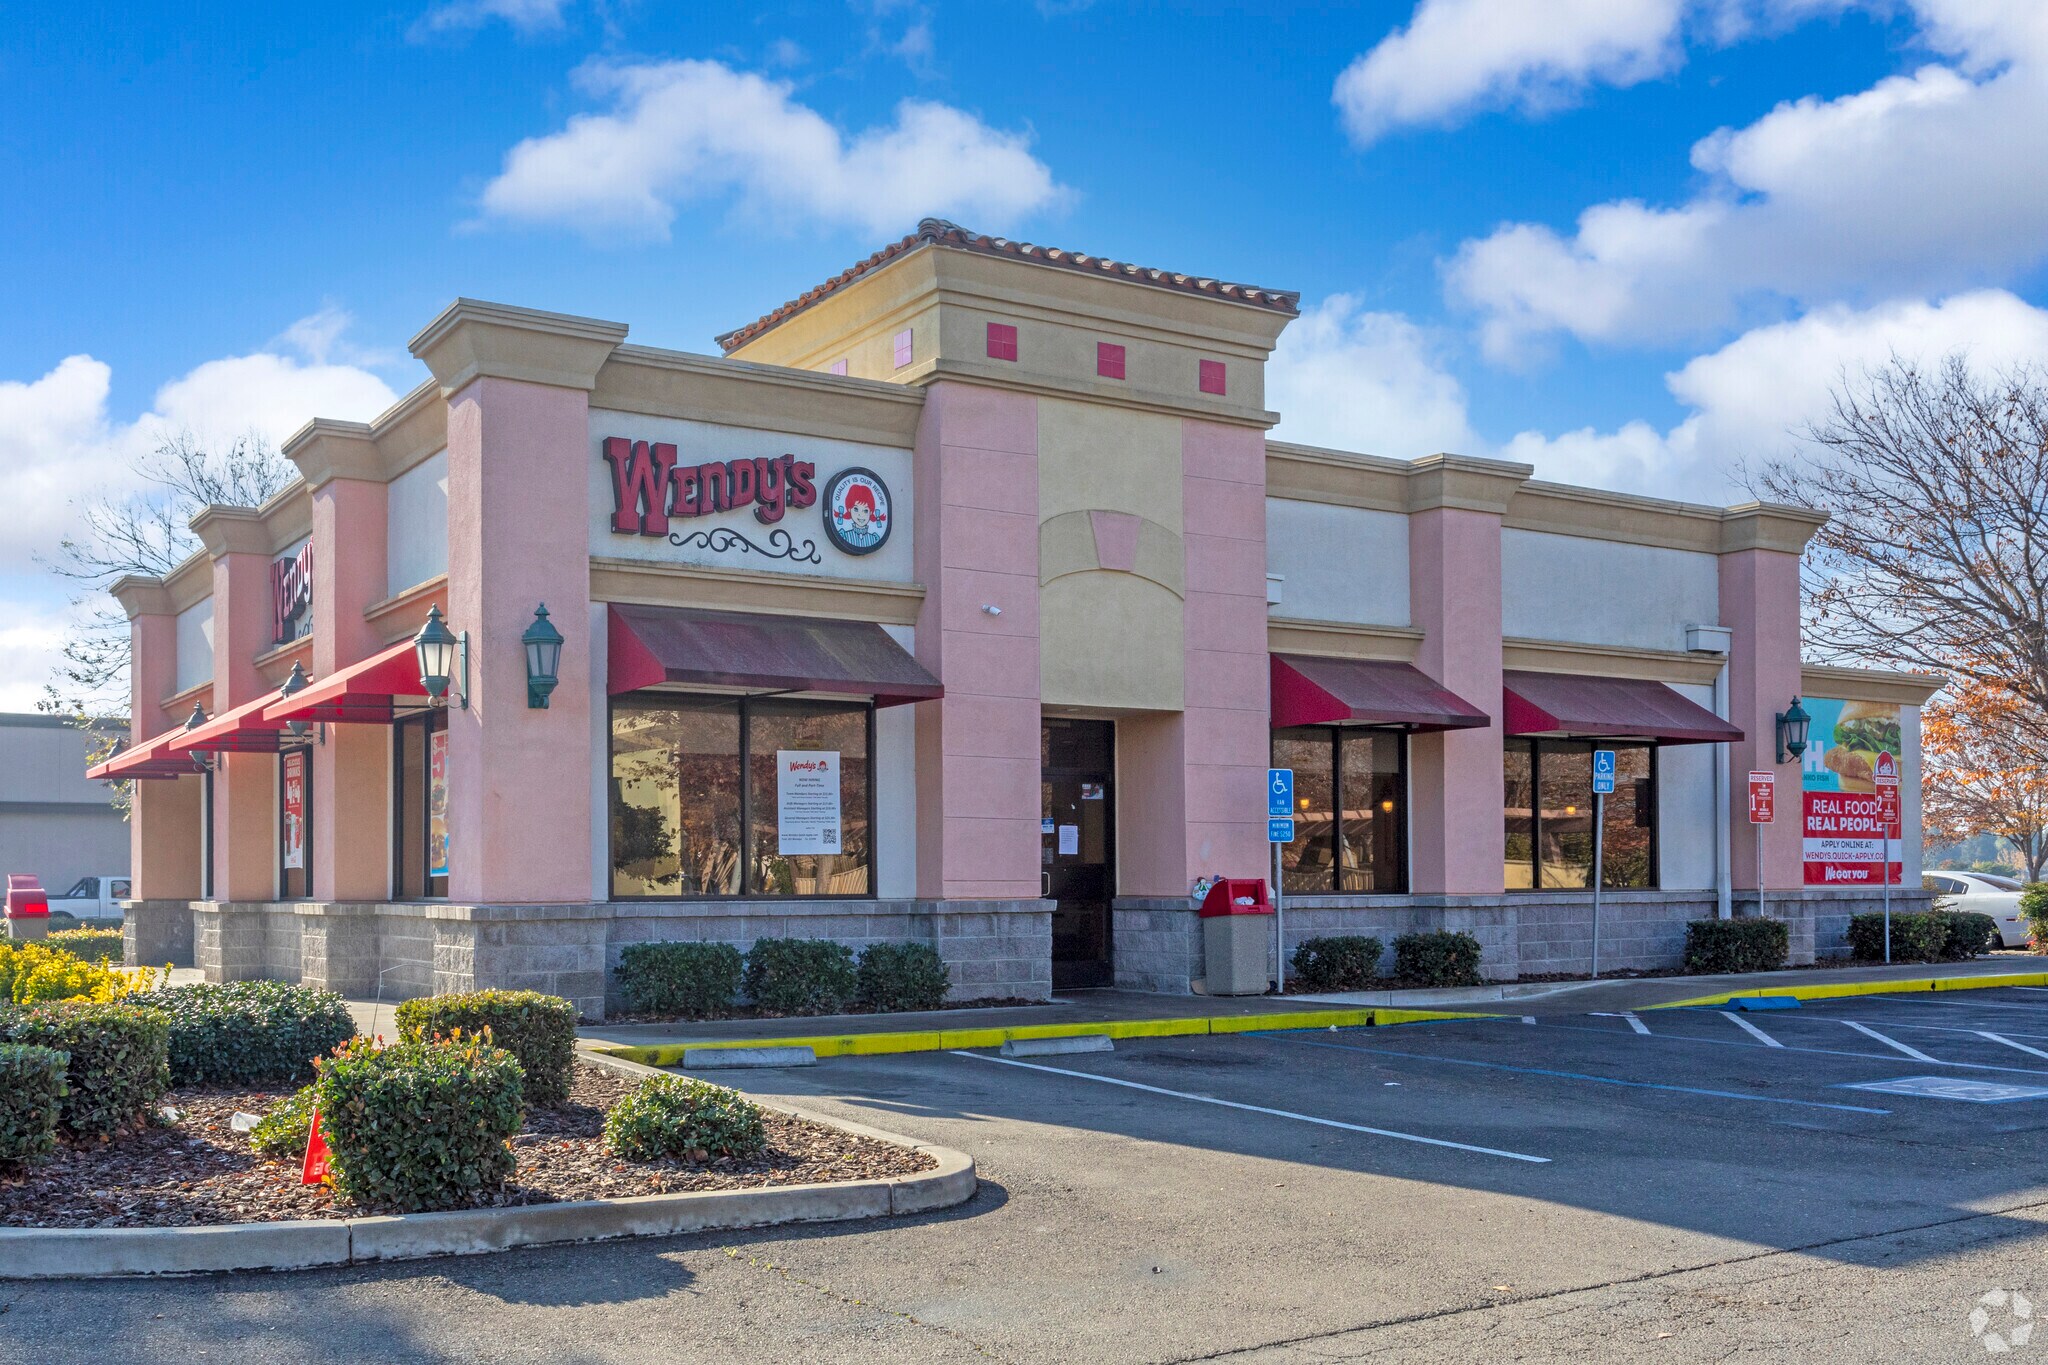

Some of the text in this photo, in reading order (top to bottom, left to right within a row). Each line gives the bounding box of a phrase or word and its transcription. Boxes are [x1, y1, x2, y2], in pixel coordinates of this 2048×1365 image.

[602, 436, 818, 537] Wendy's
[834, 479, 852, 501] QUALITY
[859, 477, 873, 487] OUR
[872, 484, 886, 506] RECIPE
[270, 536, 313, 644] Wendy
[790, 760, 817, 772] Wendy's
[1816, 774, 1830, 782] FISH
[1876, 777, 1897, 785] RESERVED
[1597, 781, 1610, 790] ONLY
[1750, 793, 1757, 811] 1
[1812, 799, 1843, 815] REAL
[1876, 795, 1883, 812] 2
[1807, 816, 1838, 831] REAL
[1270, 830, 1292, 838] FINE $250
[1820, 840, 1874, 849] APPLY ONLINE AT:
[1805, 851, 1887, 860] WENDYS.QUICK-APPLY.CO
[1836, 870, 1852, 879] GOT
[1851, 870, 1868, 879] YOU
